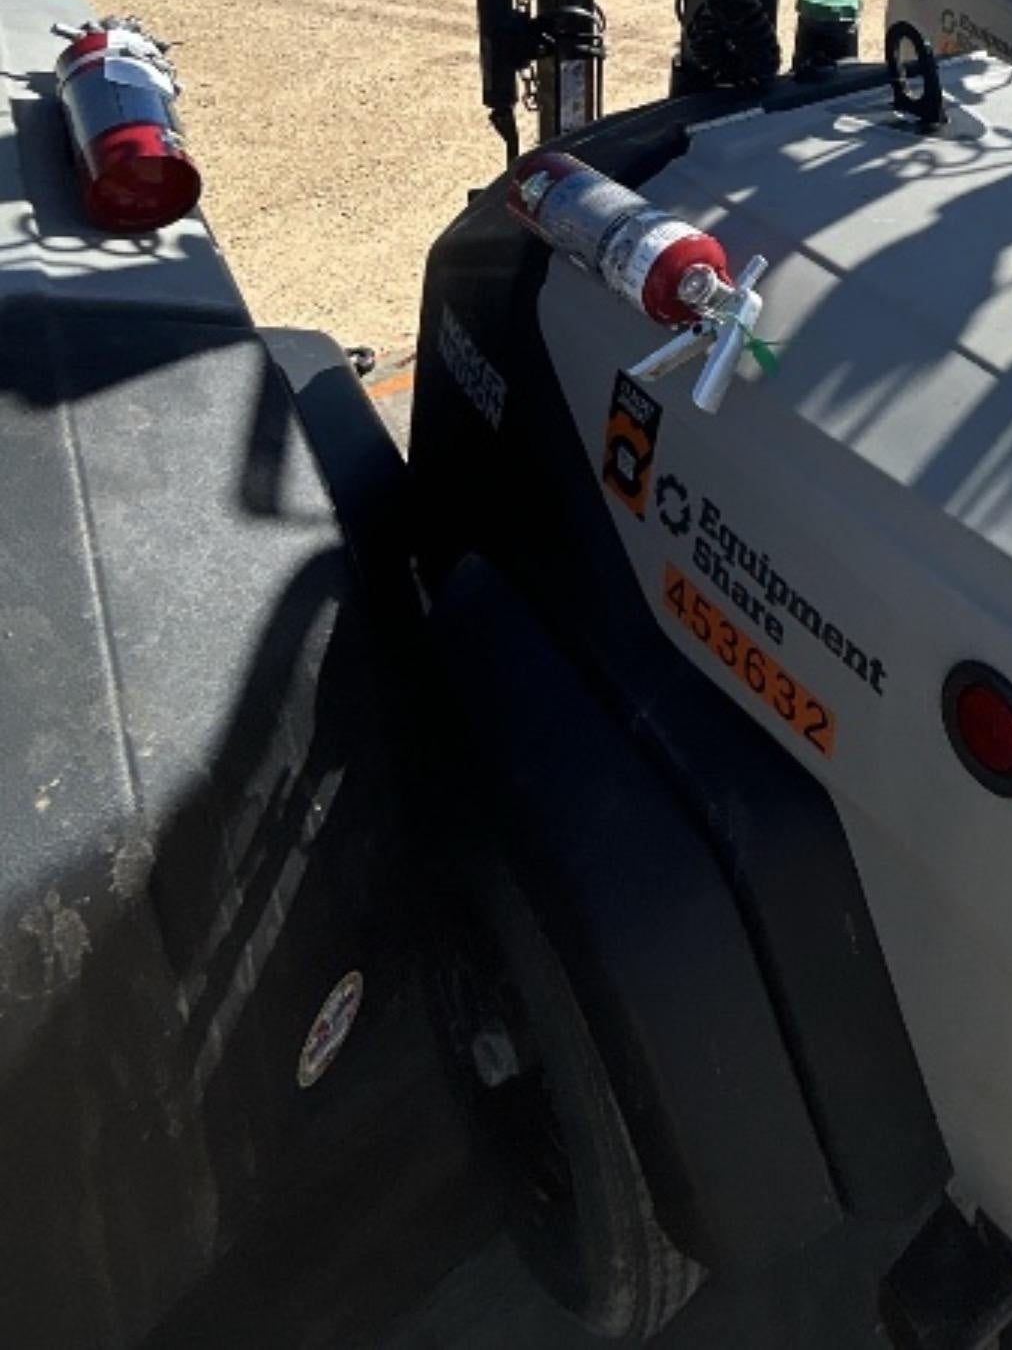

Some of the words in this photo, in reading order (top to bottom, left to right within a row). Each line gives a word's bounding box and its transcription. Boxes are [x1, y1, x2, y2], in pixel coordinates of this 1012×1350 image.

[666, 577, 829, 755] 453632
[692, 536, 785, 646] Share
[699, 497, 888, 697] Equipment
